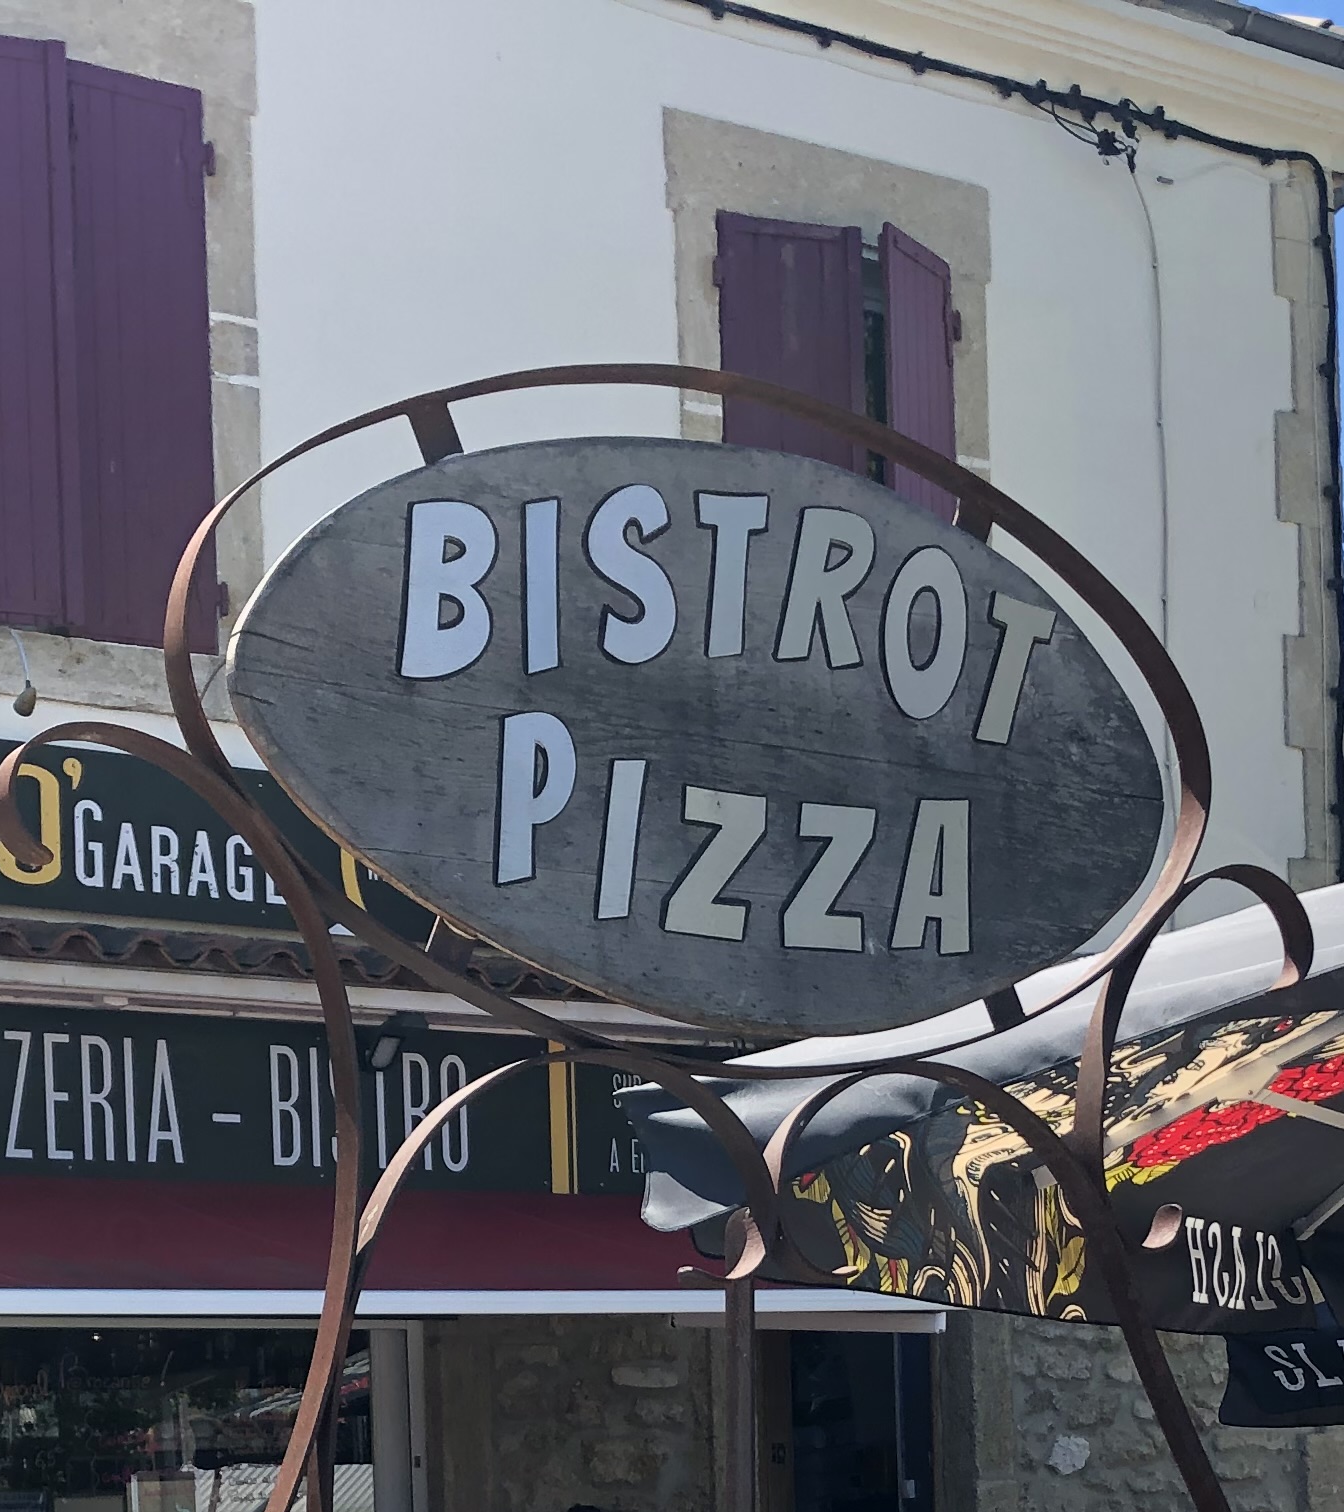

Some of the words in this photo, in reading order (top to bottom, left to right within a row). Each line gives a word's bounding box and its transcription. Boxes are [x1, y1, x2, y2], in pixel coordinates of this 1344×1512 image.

[397, 484, 1057, 746] BISTROT
[495, 711, 971, 955] PIZZA
[270, 1044, 471, 1173] BITRO
